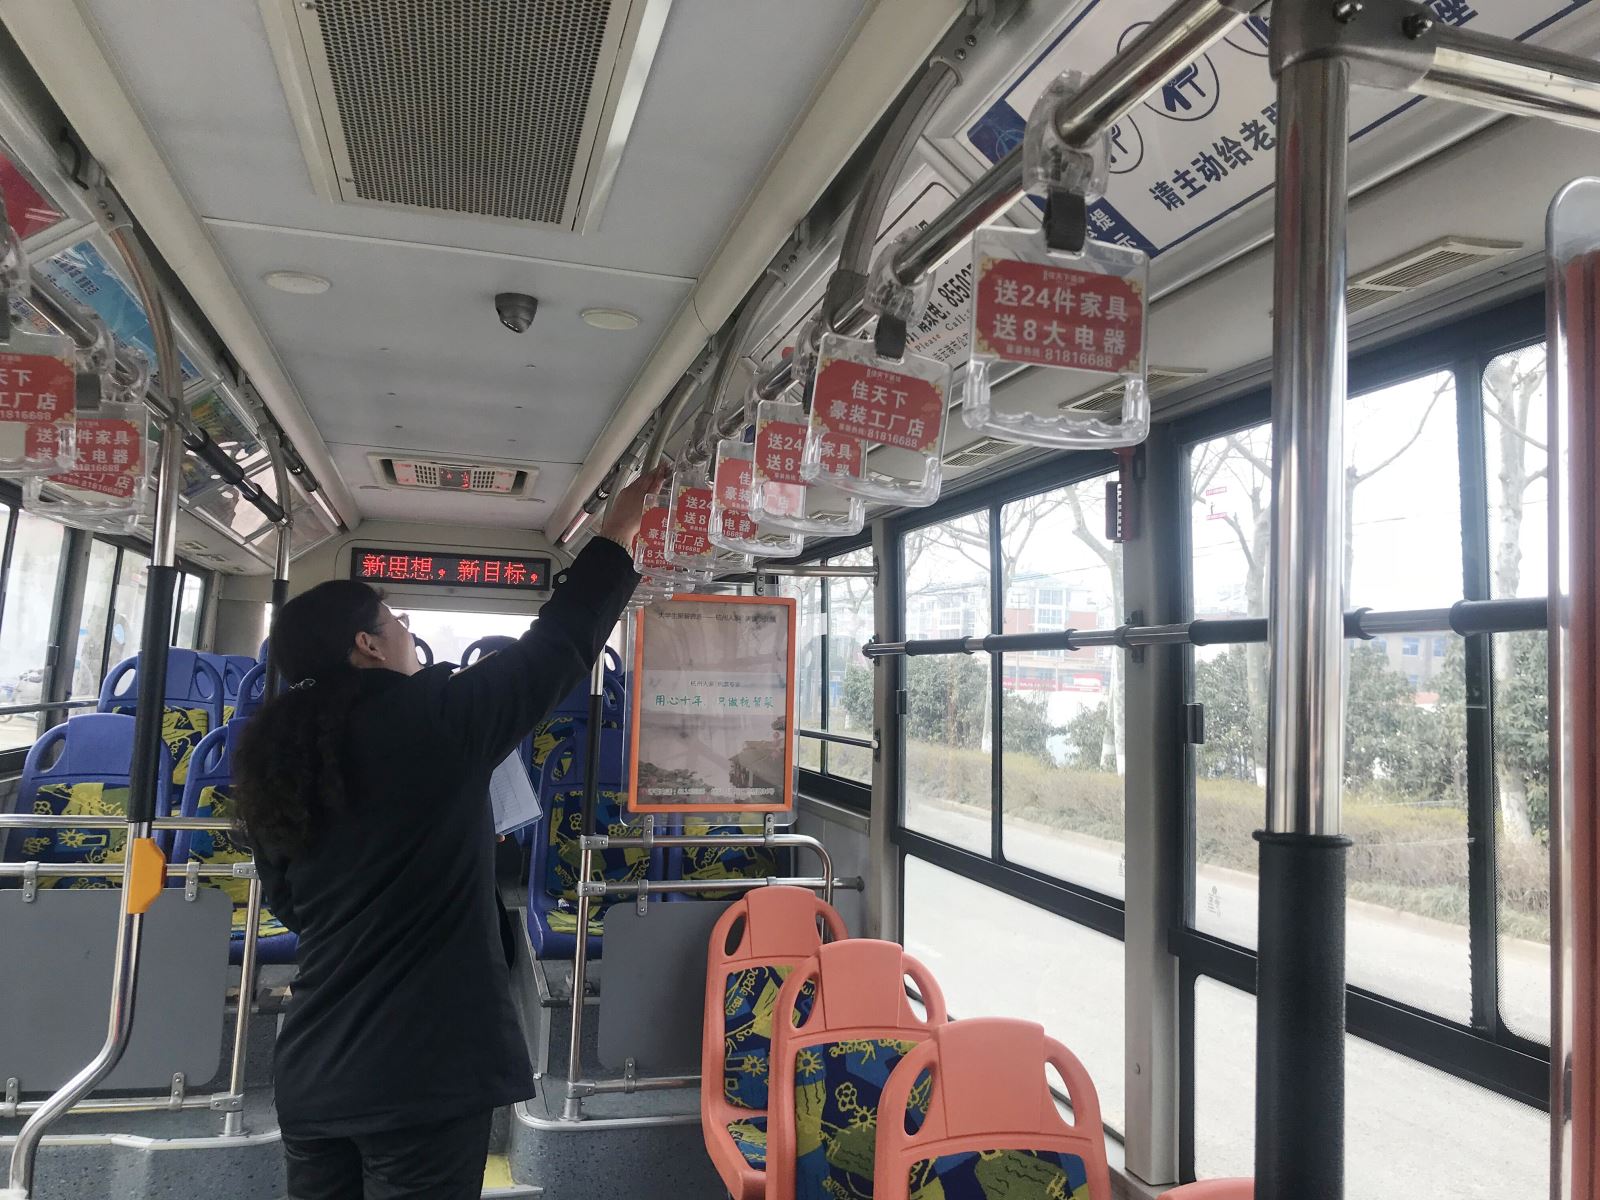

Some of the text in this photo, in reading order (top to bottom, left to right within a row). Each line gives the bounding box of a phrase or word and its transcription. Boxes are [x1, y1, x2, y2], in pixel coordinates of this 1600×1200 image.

[994, 279, 1129, 322] 送24件家具
[915, 333, 941, 353] Please
[993, 313, 1126, 355] 送8大电器
[1045, 349, 1112, 367] 81816688
[851, 379, 908, 409] 佳天下
[829, 399, 926, 438] 豪装工厂店
[867, 430, 918, 448] 81816688
